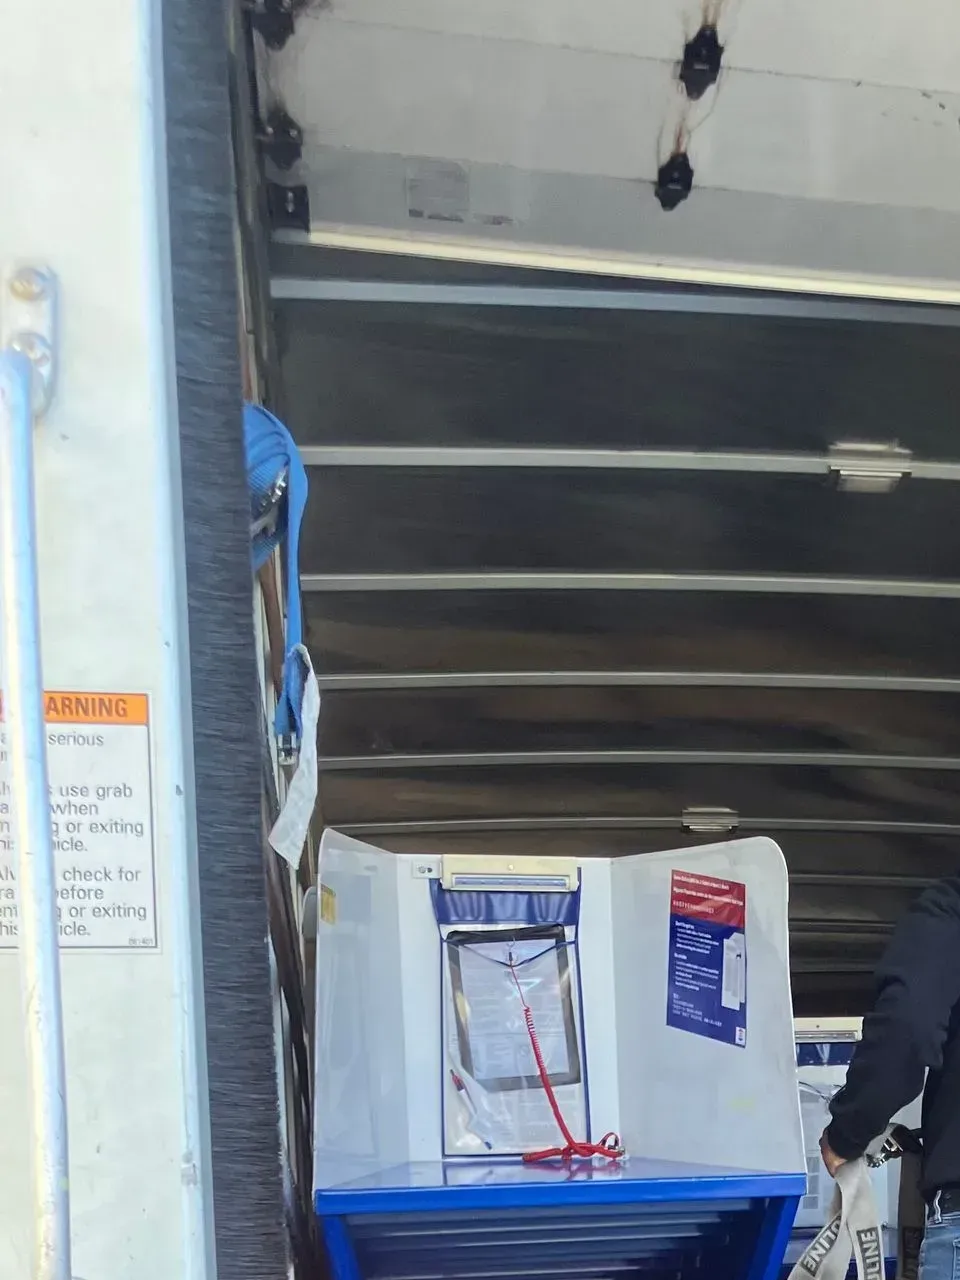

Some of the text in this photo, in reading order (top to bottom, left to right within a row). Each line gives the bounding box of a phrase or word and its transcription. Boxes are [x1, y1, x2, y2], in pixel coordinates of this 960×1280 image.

[45, 695, 129, 719] ARNING
[48, 732, 105, 748] serious
[59, 782, 133, 802] use grab
[51, 799, 99, 816] when
[65, 820, 84, 834] or
[89, 818, 145, 837] exiting
[62, 866, 142, 882] check for
[68, 905, 87, 919] or
[92, 903, 148, 922] exiting
[803, 1217, 842, 1272] ULINE
